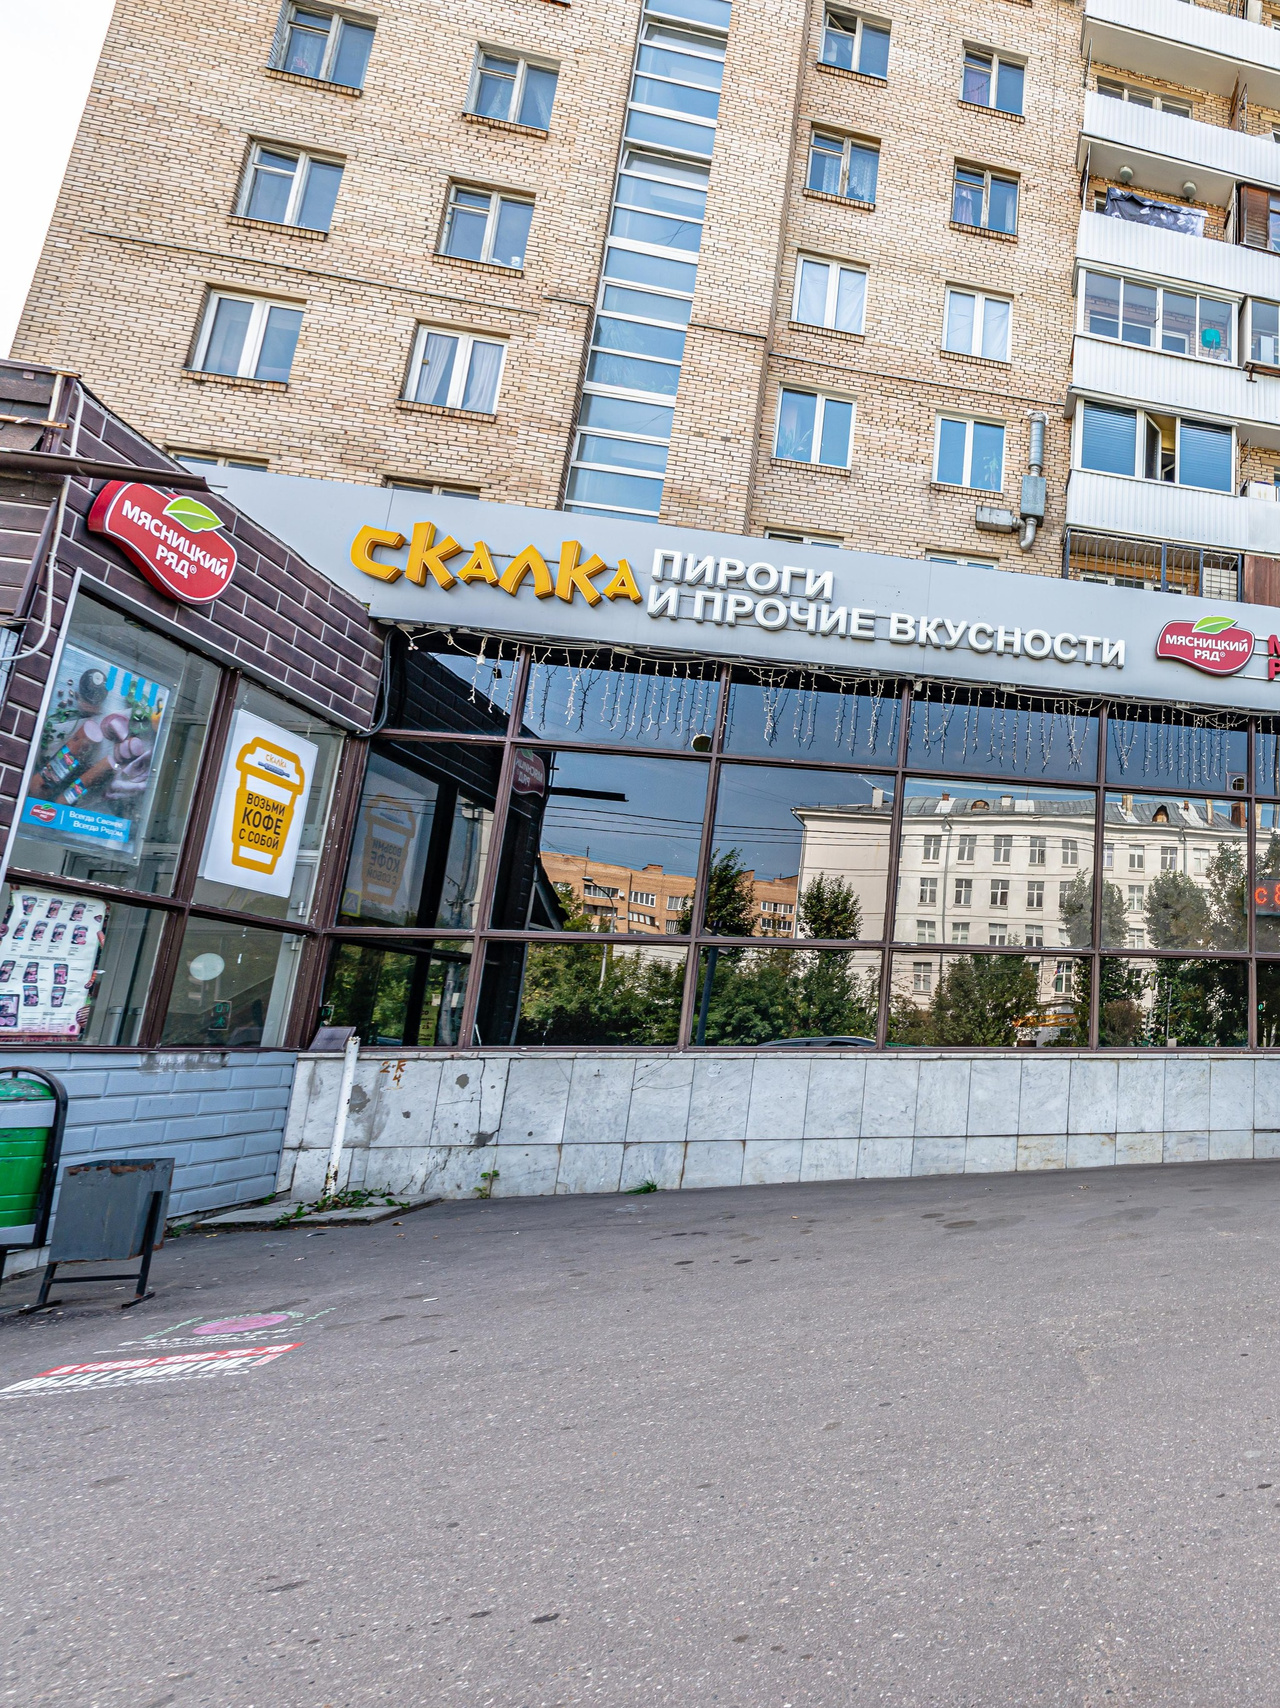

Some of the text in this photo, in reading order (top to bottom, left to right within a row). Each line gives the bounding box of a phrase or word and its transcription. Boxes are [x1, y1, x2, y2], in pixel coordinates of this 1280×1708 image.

[122, 500, 228, 580] МЯСНИЦКИЙ
[651, 548, 834, 603] ПИРОГИ
[646, 584, 1127, 670] И ПРОЧИЕ ВКУСНОСТИ
[1165, 634, 1248, 653] МЯСНИЦКИЙ
[246, 793, 286, 817] ВОЗЬМИ
[241, 807, 283, 836] КОФЕ
[239, 828, 280, 851] С СОБОЙ
